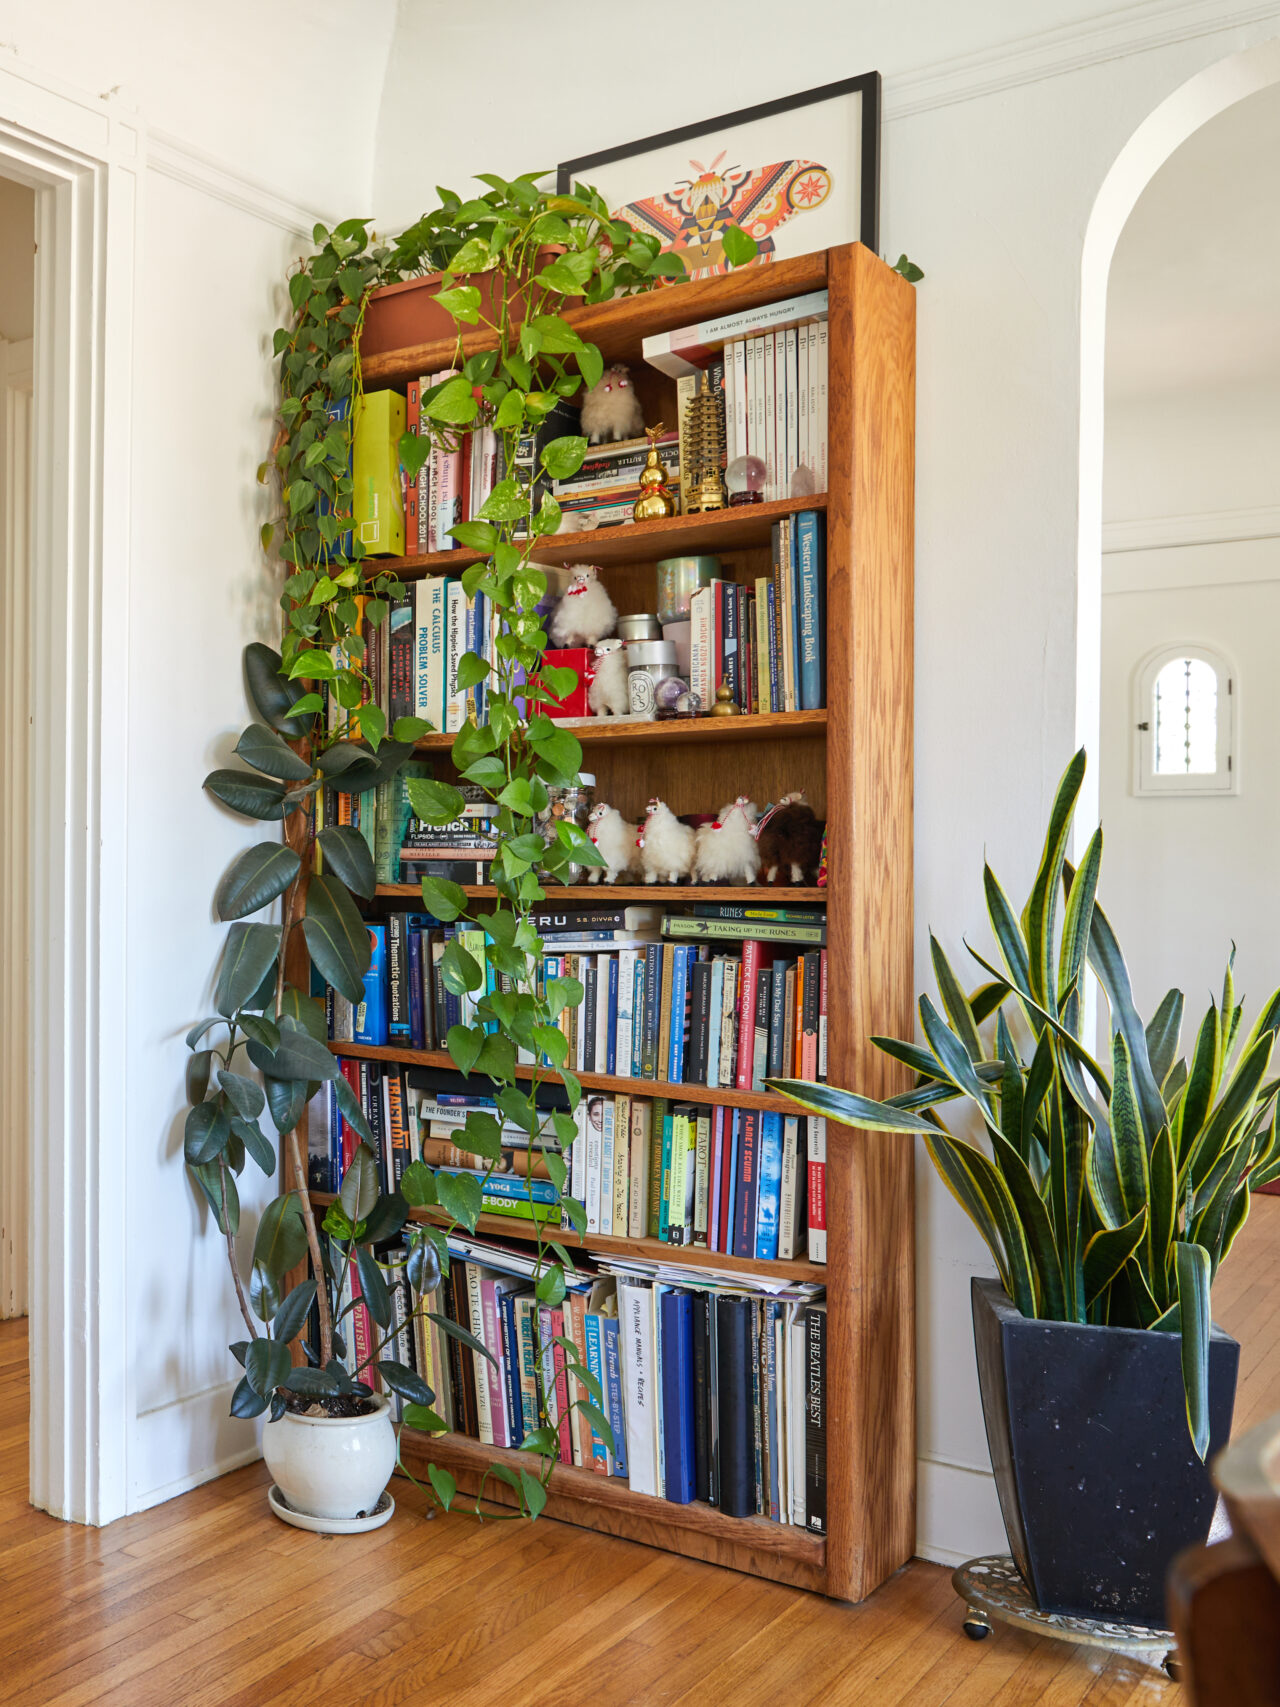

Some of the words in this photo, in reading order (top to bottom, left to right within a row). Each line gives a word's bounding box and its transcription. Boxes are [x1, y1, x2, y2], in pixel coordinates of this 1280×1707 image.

[720, 320, 744, 330] ALMOST
[745, 313, 768, 324] ALWAYS
[770, 306, 795, 318] HUNGRY
[713, 366, 722, 385] Who
[617, 456, 642, 465] BUTLER
[419, 467, 428, 487] HIGH
[419, 489, 427, 522] SCHOOL
[419, 525, 427, 543] 2014
[801, 532, 813, 572] Western
[432, 587, 441, 604] THE
[450, 600, 458, 613] How
[800, 575, 814, 636] Landscaping
[432, 608, 441, 654] CALCULUS
[450, 615, 458, 626] the
[418, 627, 428, 670] PROBLEM
[448, 627, 458, 651] Hippies
[804, 637, 815, 663] Book
[450, 653, 458, 672] Saved
[418, 674, 428, 708] SOLVER
[448, 674, 458, 698] Physics
[419, 818, 469, 832] French
[518, 916, 567, 926] ERU
[720, 907, 742, 918] RUNES
[713, 924, 740, 934] TAKING
[743, 926, 752, 934] UP
[769, 928, 797, 937] RUNES
[390, 939, 401, 979] Thematic
[648, 946, 656, 975] STATION
[743, 944, 753, 978] PATRICK
[390, 980, 401, 1022] Quotations
[741, 980, 752, 1019] LENCIONI
[773, 988, 782, 998] My
[774, 999, 782, 1012] Dad
[773, 1013, 781, 1027] Says
[388, 1076, 404, 1149] TRACTION
[425, 1106, 435, 1114] THE
[437, 1108, 465, 1118] FOUNDER'S
[744, 1115, 753, 1148] PLANET
[653, 1145, 661, 1179] DRUNKEN
[697, 1131, 708, 1168] TAROT
[784, 1137, 793, 1184] Hemingway
[743, 1150, 752, 1182] SCUMM
[489, 1182, 510, 1193] YOGI
[652, 1181, 660, 1216] BOTANIST
[468, 1266, 479, 1290] TAO
[470, 1291, 480, 1307] TE
[766, 1305, 775, 1318] The
[632, 1299, 642, 1336] APPLIANCE
[766, 1319, 776, 1338] Blues
[810, 1314, 821, 1340] THE
[505, 1348, 510, 1356] OF
[606, 1330, 615, 1349] Easy
[766, 1338, 776, 1365] Fakebook
[608, 1350, 618, 1379] French
[635, 1338, 643, 1368] MANUALS
[809, 1341, 821, 1394] BEATLES
[637, 1377, 645, 1408] RECIPES
[610, 1382, 620, 1434] STEP-BY-STEP
[810, 1395, 821, 1427] BEST
